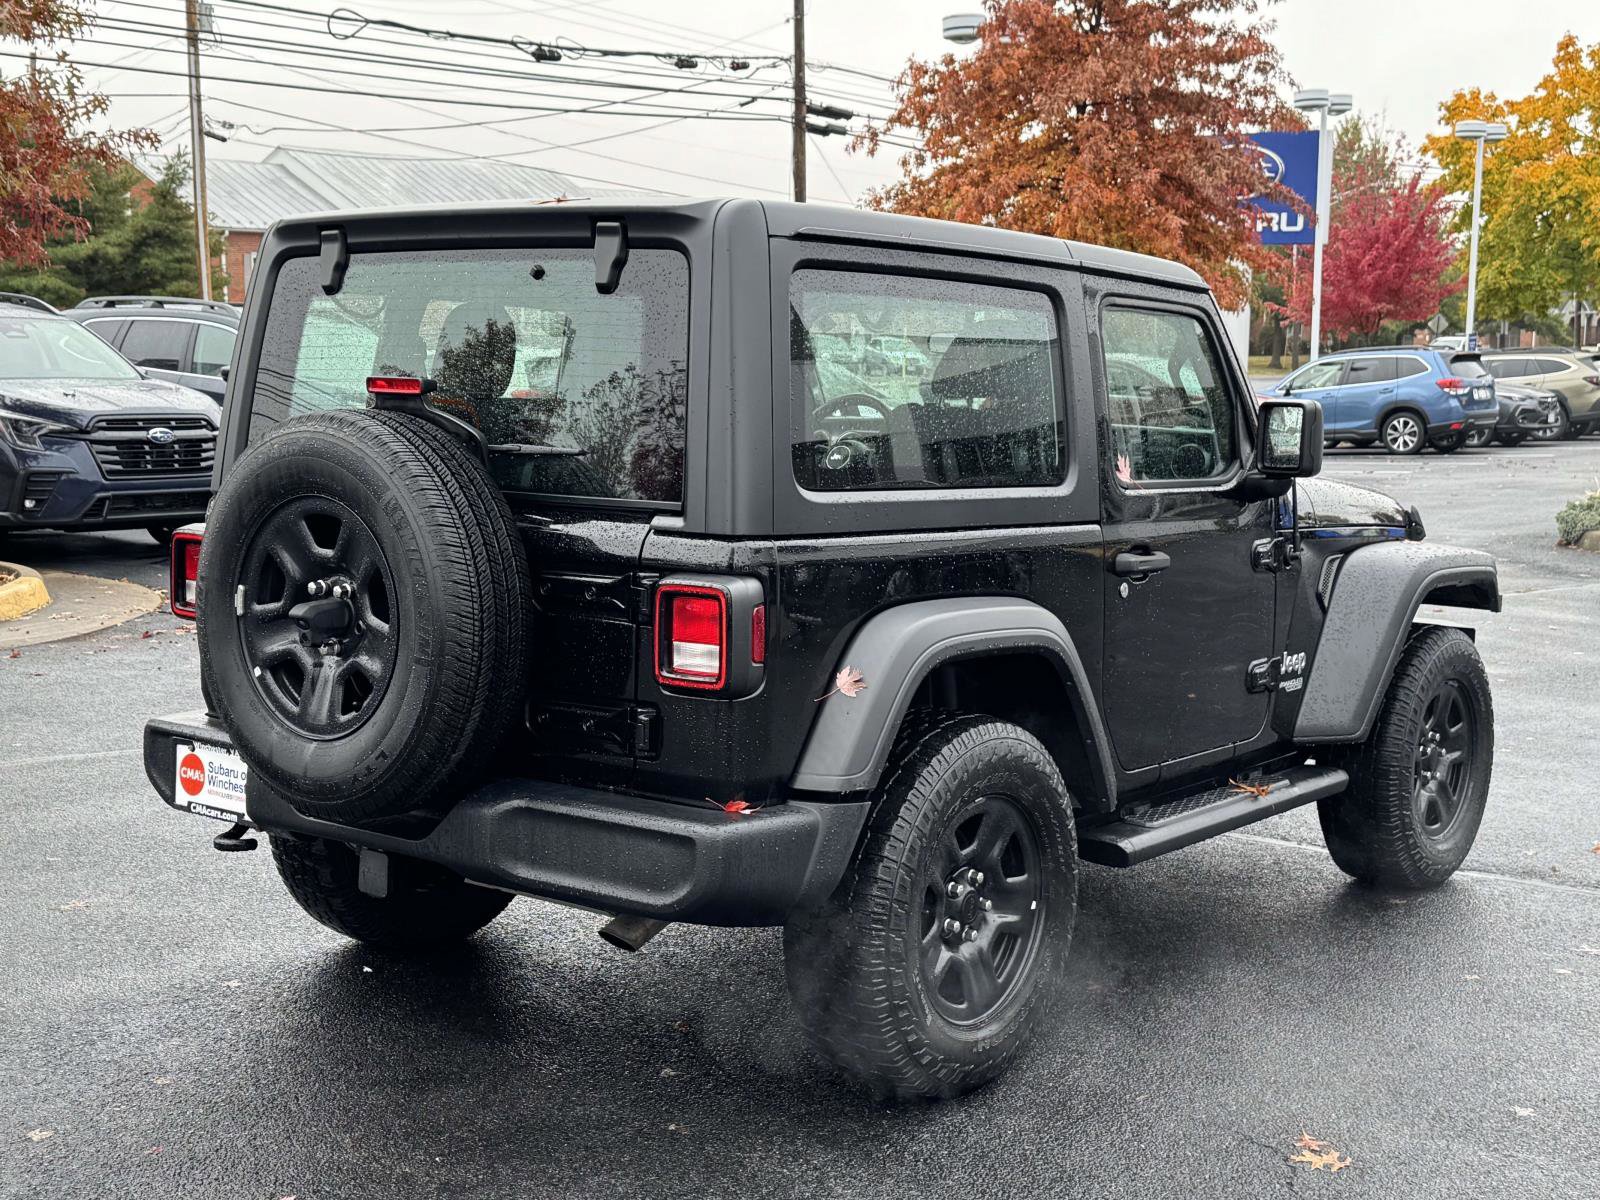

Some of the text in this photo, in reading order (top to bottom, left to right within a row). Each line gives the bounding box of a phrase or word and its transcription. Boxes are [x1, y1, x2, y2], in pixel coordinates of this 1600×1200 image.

[1280, 651, 1306, 675] Jeep
[180, 766, 204, 782] CMA's
[208, 761, 239, 779] Subaru
[190, 802, 238, 822] CMAcars.com
